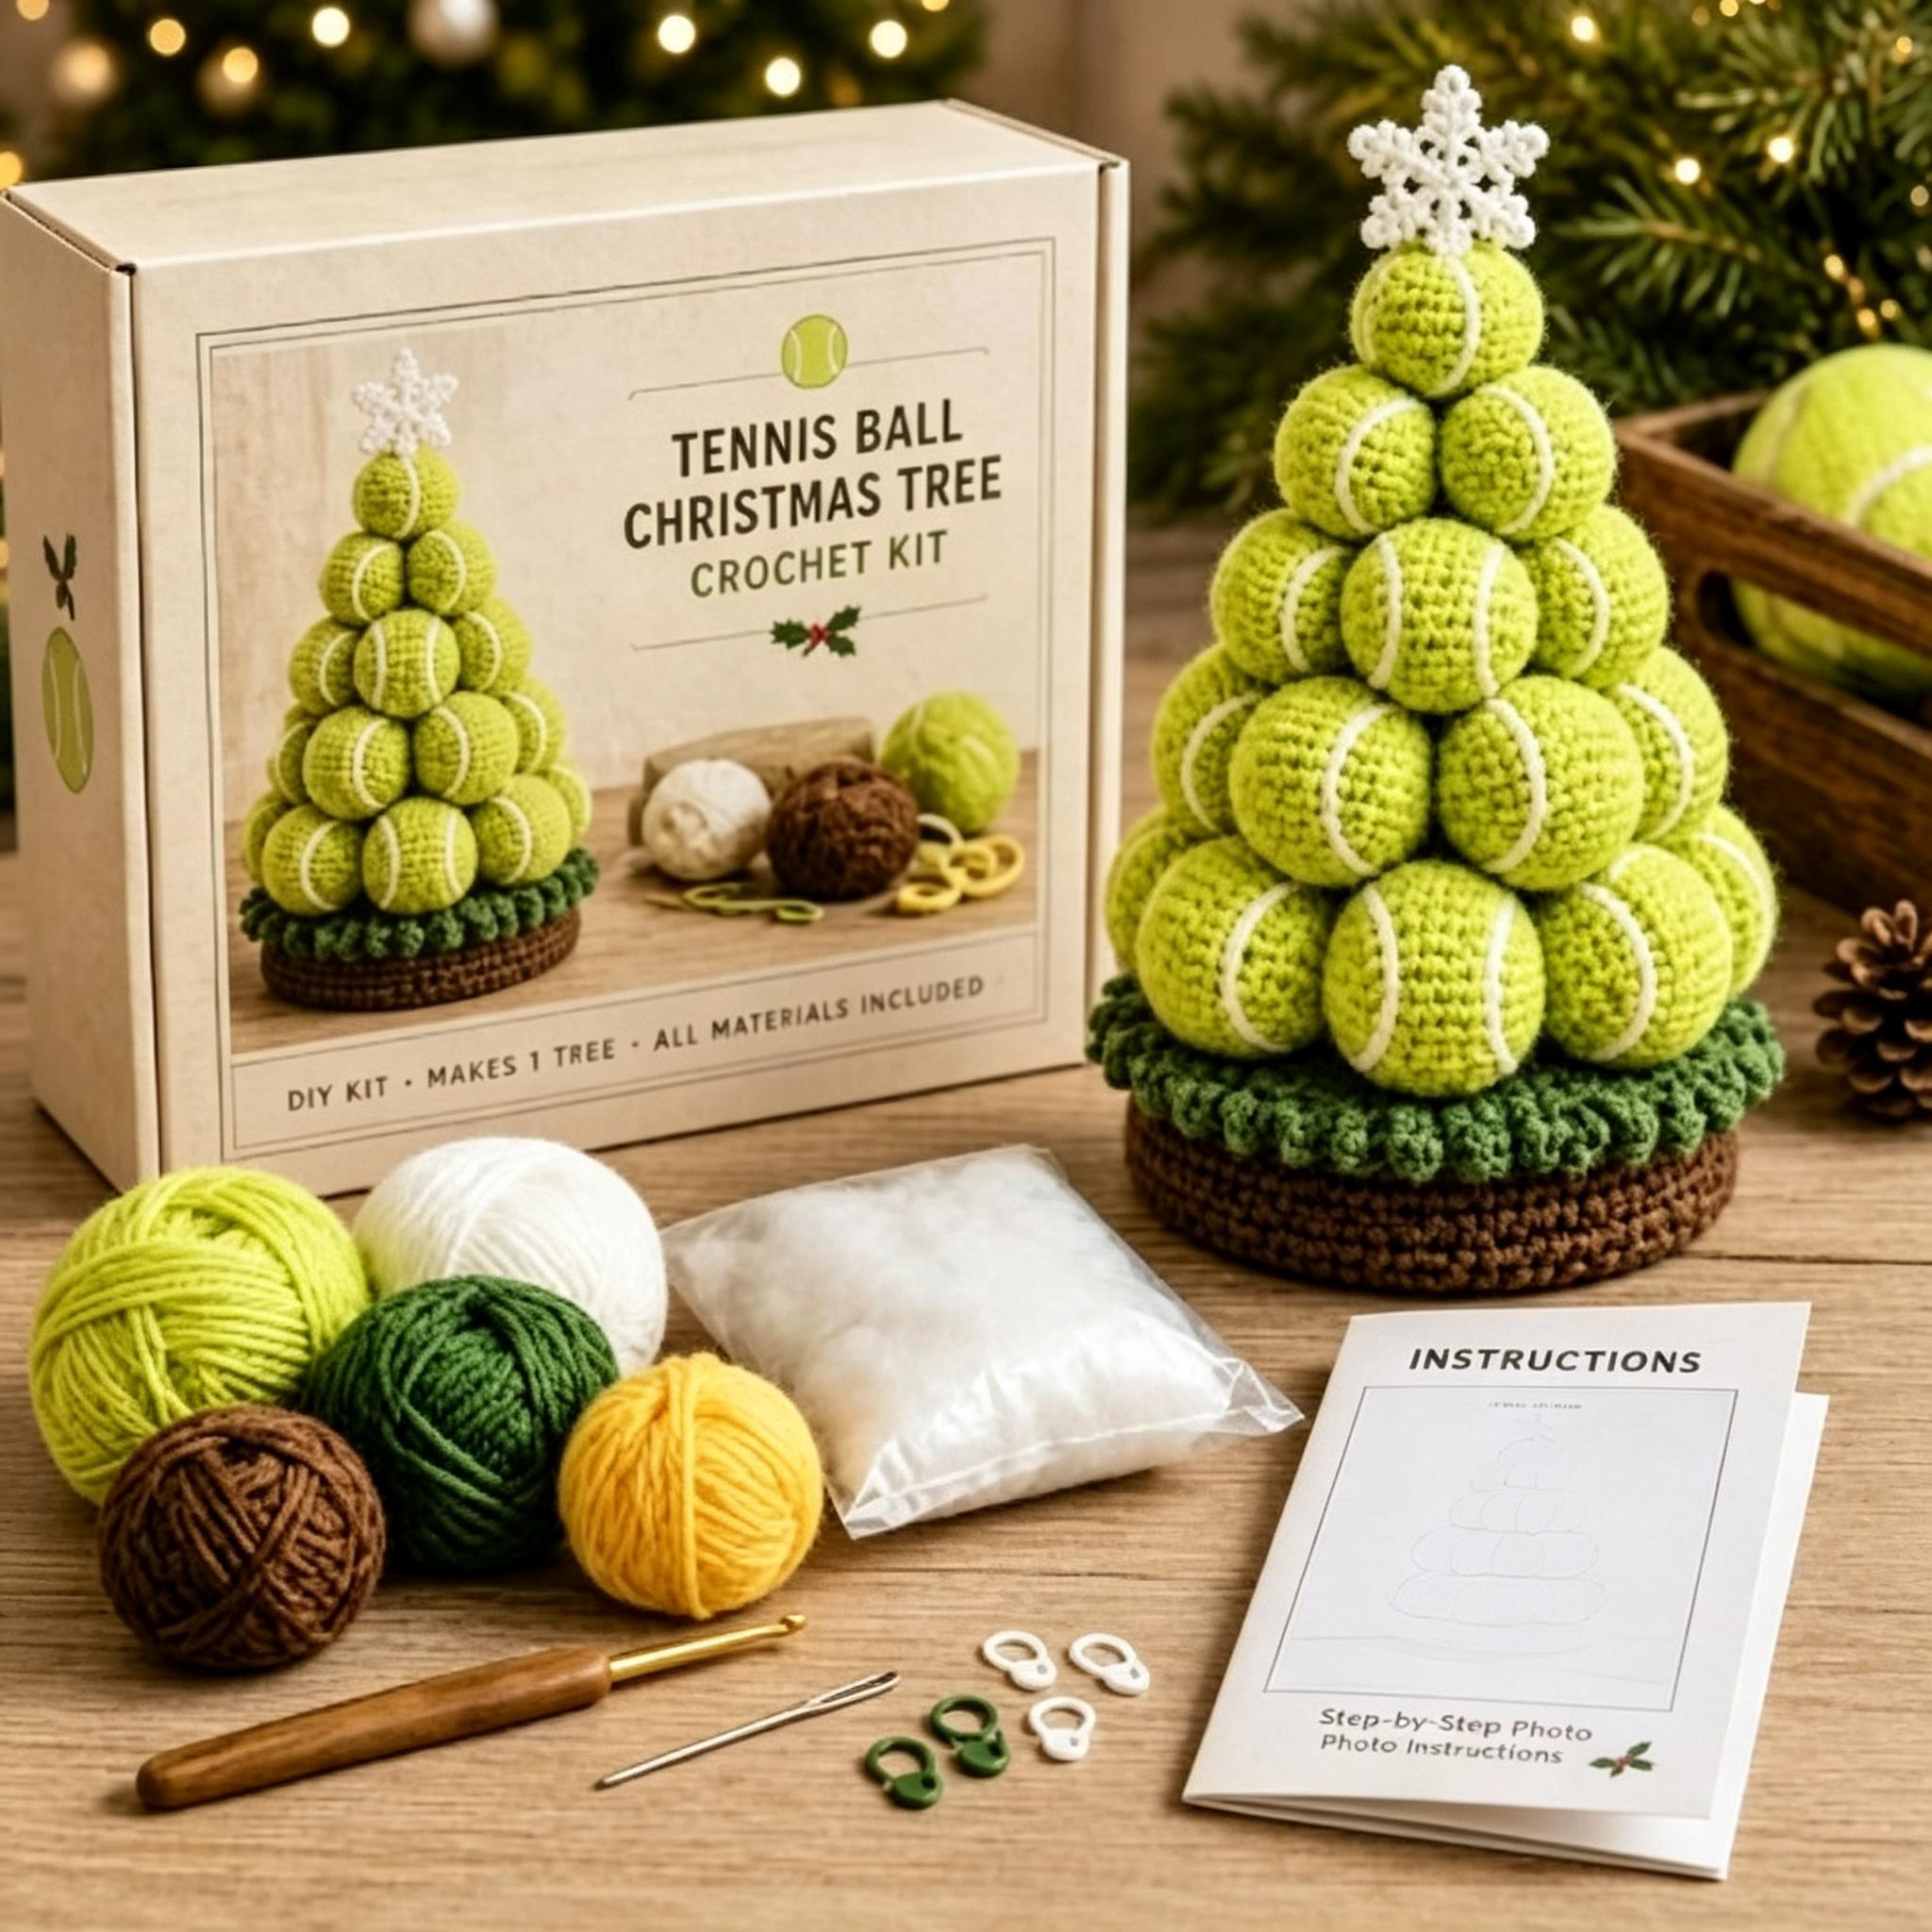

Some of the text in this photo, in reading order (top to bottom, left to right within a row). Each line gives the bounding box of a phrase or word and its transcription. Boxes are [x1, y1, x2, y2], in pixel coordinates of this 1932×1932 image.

[673, 399, 962, 477] TENNIS BALL
[625, 455, 1002, 549] CHRISTMAS TREE
[691, 529, 947, 597] CROCHET KIT
[289, 976, 984, 1111] DIY KIT MAKES 1 TREE ALL MATERIALS INCLUDED
[1409, 1349, 1701, 1374] INSTRUCTIONS
[1320, 1708, 1592, 1741] Step-by-Step Photo
[1321, 1734, 1562, 1763] Photo Instructions
